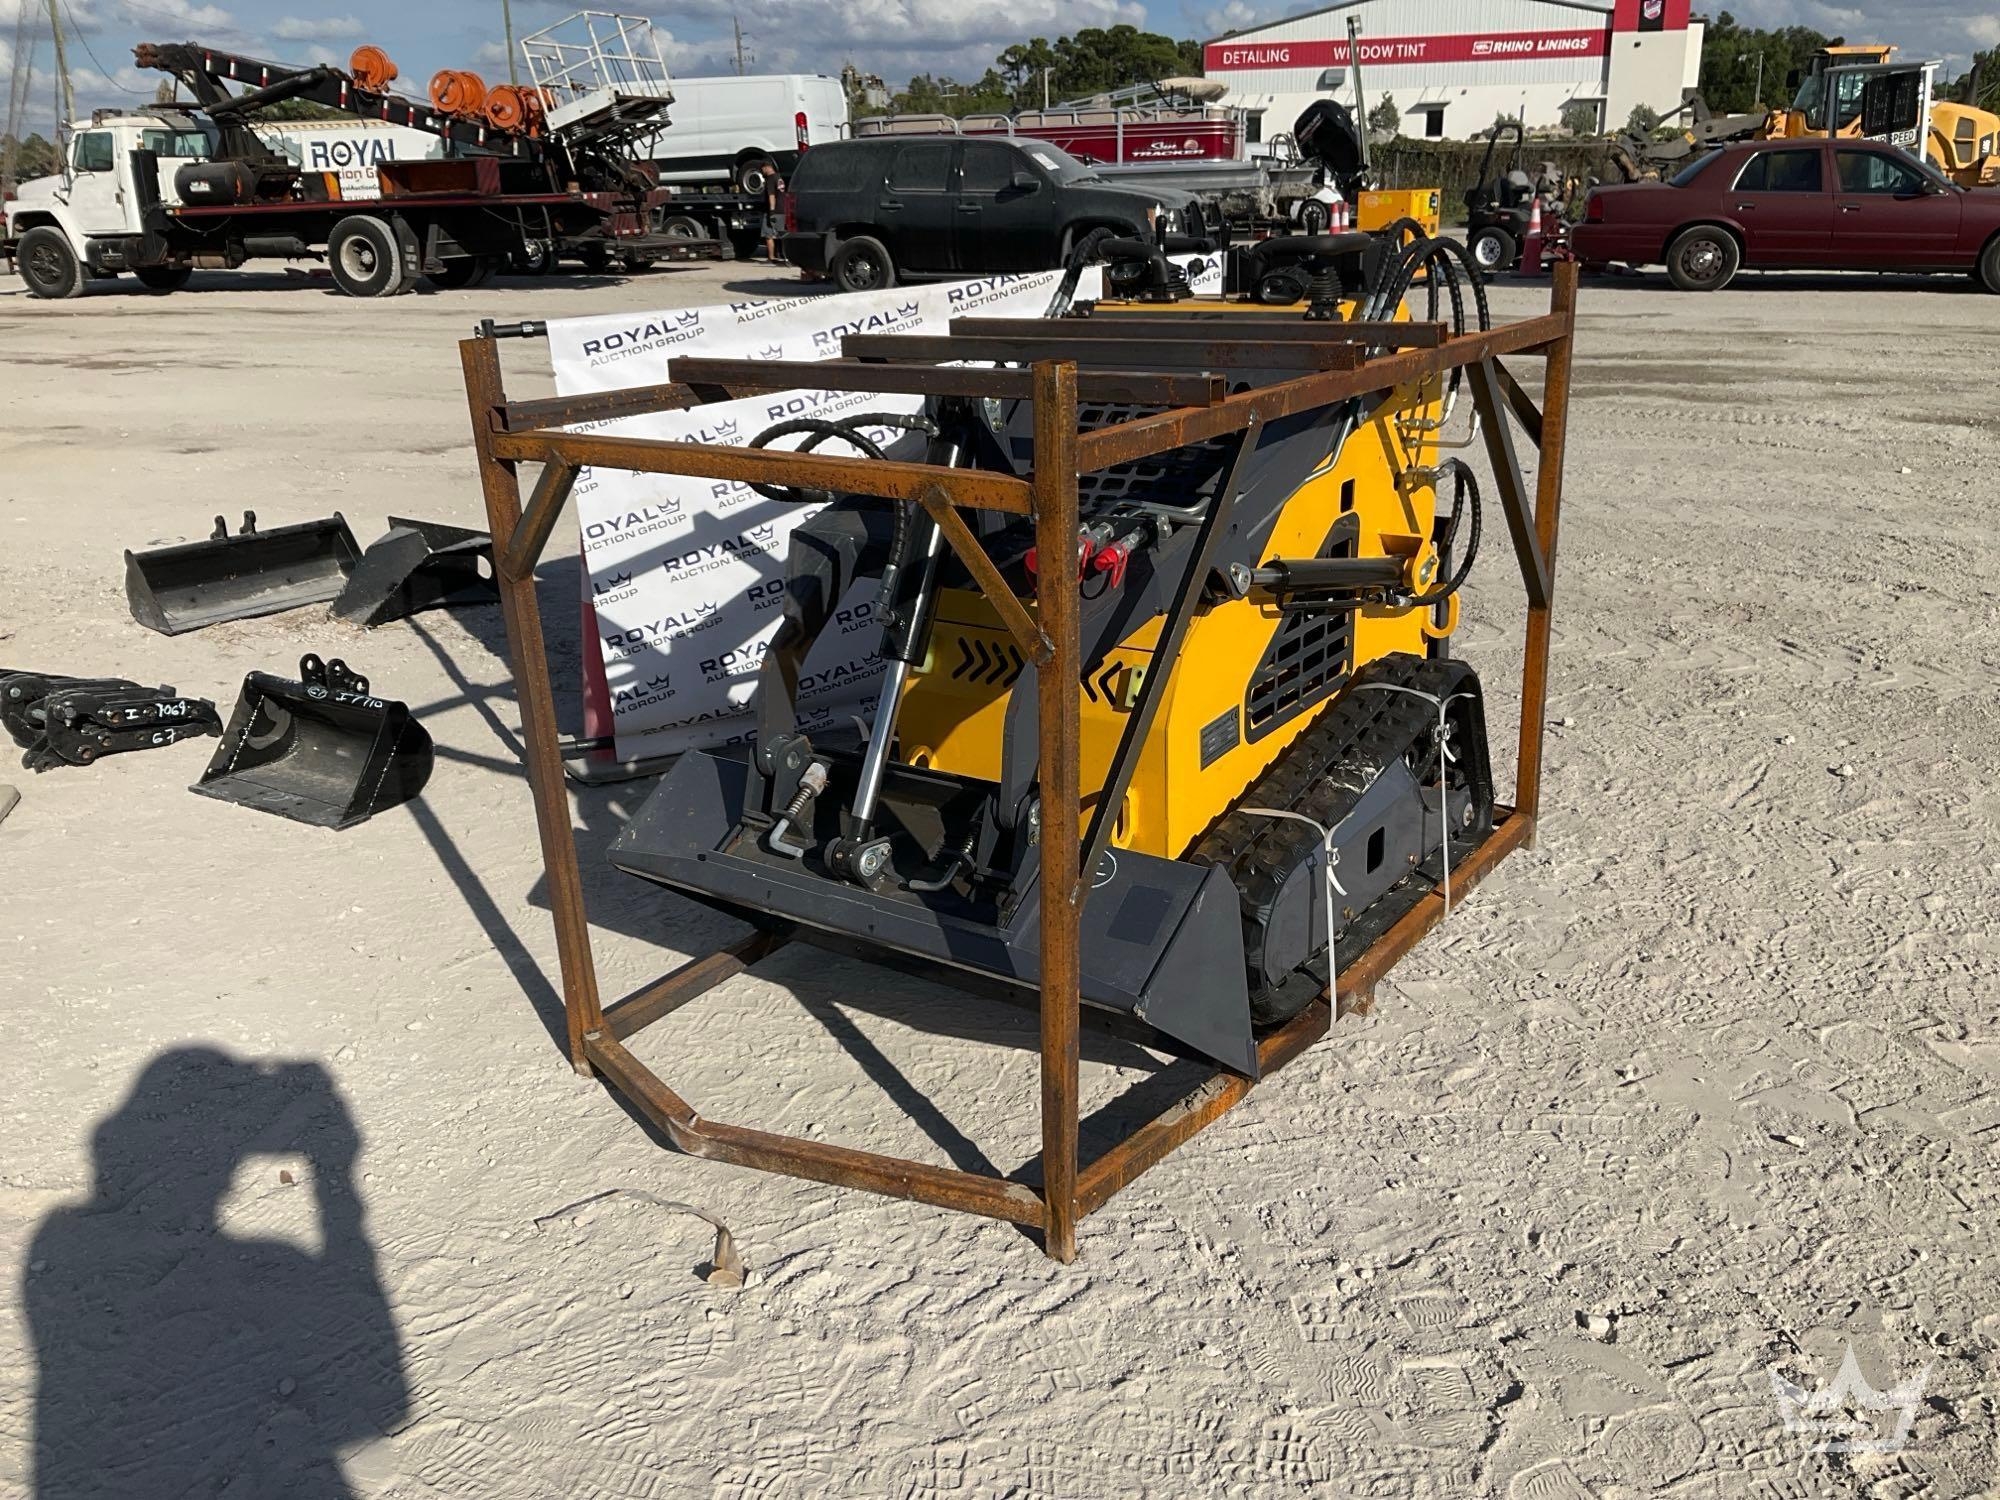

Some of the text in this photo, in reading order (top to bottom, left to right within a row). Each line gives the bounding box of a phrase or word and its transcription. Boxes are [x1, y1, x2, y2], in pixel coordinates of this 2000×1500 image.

[1223, 49, 1289, 65] DETAILING
[1333, 43, 1426, 60] WIDOW TINT
[1493, 38, 1589, 53] RHINO LININGS
[1890, 130, 1914, 144] PEED
[1131, 149, 1204, 158] TRACKER
[952, 274, 1054, 314] AUCTION GROUP
[737, 300, 797, 324] AUCTION
[582, 320, 678, 356] ROYAL
[811, 311, 898, 347] ROYAL
[590, 327, 705, 368] AUCTION GROUP
[796, 405, 833, 420] TION
[718, 490, 758, 509] AUCT
[585, 508, 660, 539] OYAL
[638, 513, 687, 536] GROUP
[663, 535, 753, 573] ROYAL
[670, 540, 780, 583] AUCTION GROUP
[605, 612, 696, 650] ROYAL
[841, 617, 875, 635] AUCT
[612, 617, 723, 661] AUCTION GROUP
[699, 640, 770, 675] ROYA
[798, 661, 864, 691] OYAL
[843, 664, 888, 686] GROUP
[628, 689, 676, 712] GROUP
